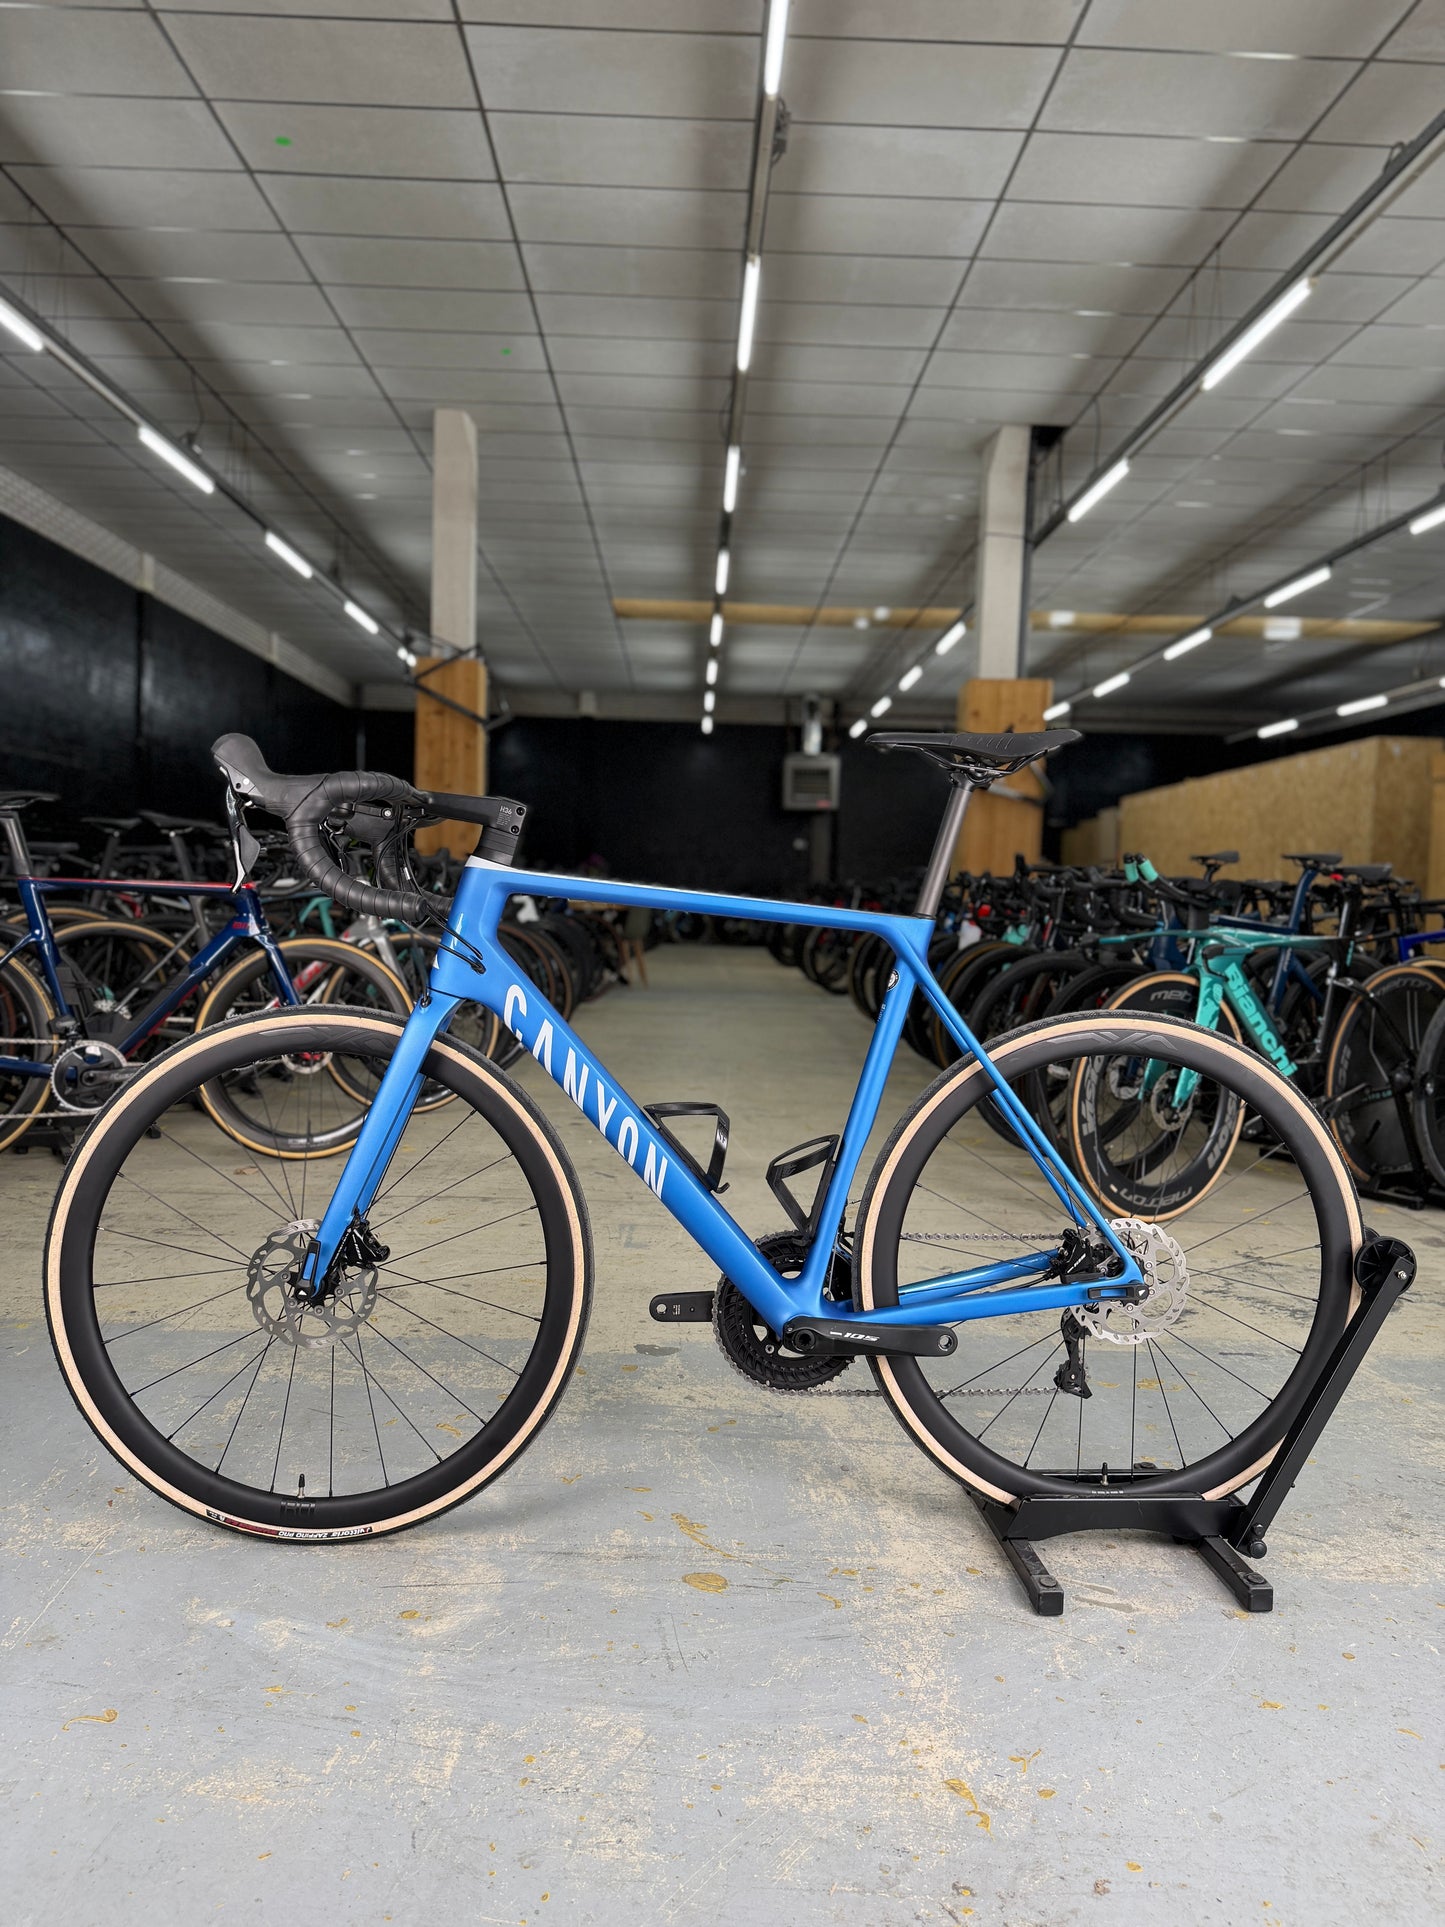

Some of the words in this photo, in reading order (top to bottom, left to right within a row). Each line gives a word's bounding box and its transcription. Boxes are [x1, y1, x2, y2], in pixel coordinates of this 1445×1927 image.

[1150, 989, 1193, 1003] met
[1224, 962, 1298, 1077] Bianchi
[504, 984, 668, 1199] CANYON
[1120, 1186, 1192, 1208] metron
[843, 1332, 880, 1342] 105
